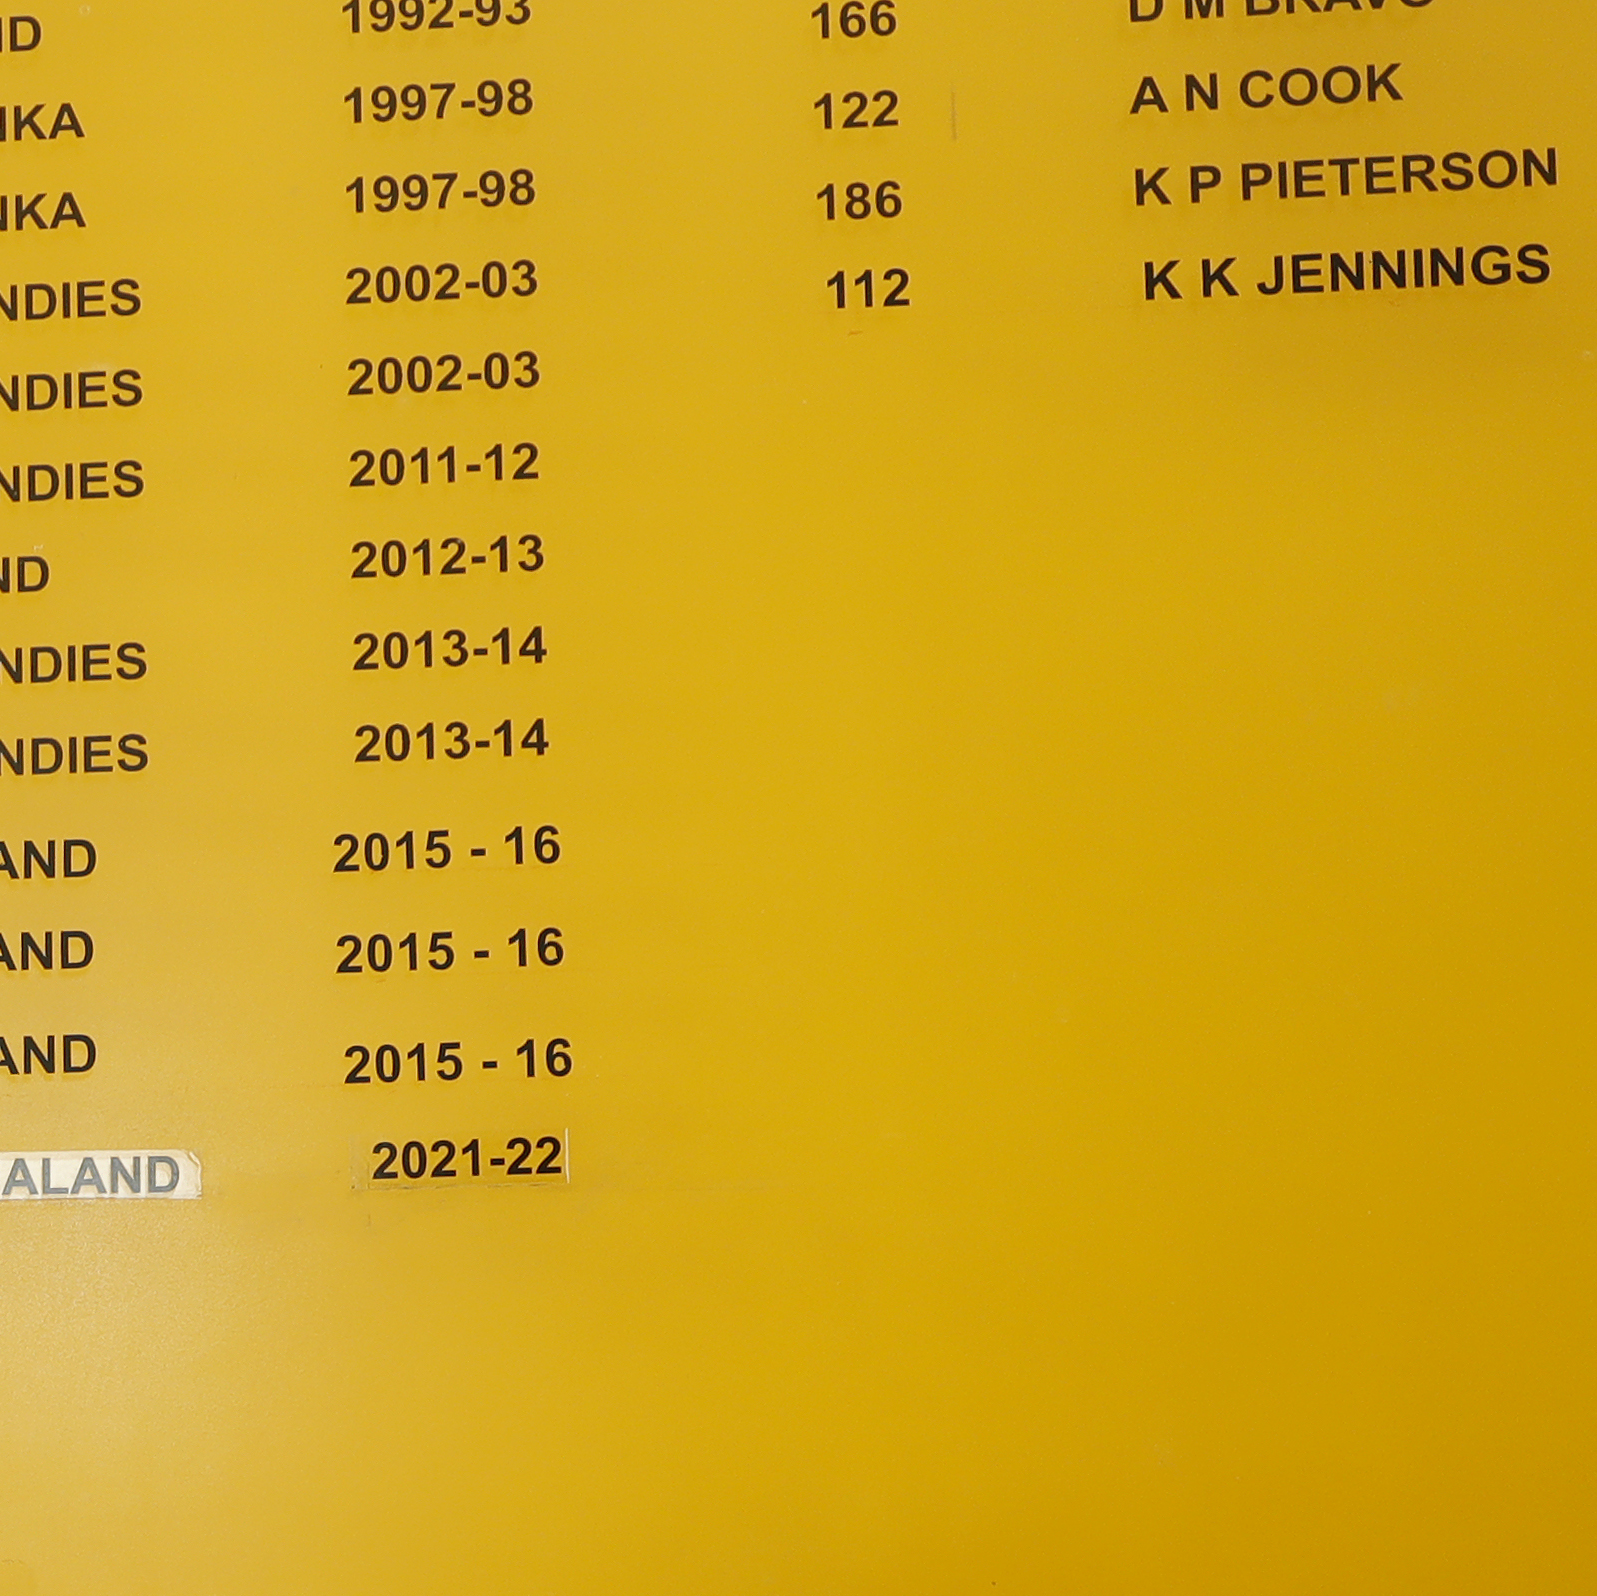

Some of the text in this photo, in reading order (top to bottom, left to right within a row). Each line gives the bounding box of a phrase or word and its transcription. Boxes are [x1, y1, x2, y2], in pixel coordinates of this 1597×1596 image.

[812, 0, 898, 40] 166
[343, 78, 534, 124] 1997-98
[813, 89, 899, 130] 122
[1129, 62, 1404, 115] A N COOK
[345, 167, 536, 214] 1997-98
[816, 179, 903, 221] 186
[1134, 147, 1558, 207] K P PIETERSON
[345, 258, 538, 305] 2002-03
[826, 267, 911, 310] 112
[1143, 243, 1551, 301] K K JENNINGS
[347, 350, 540, 396] 2002-03
[349, 442, 539, 488] 2011-12
[350, 533, 544, 580] 2012-13
[352, 625, 548, 671] 2013-14
[354, 717, 550, 764] 2013-14
[332, 824, 561, 873] 2015 16
[335, 926, 564, 974] 2015 16
[343, 1037, 573, 1085] 2015 16
[371, 1135, 563, 1180] 2021-22
